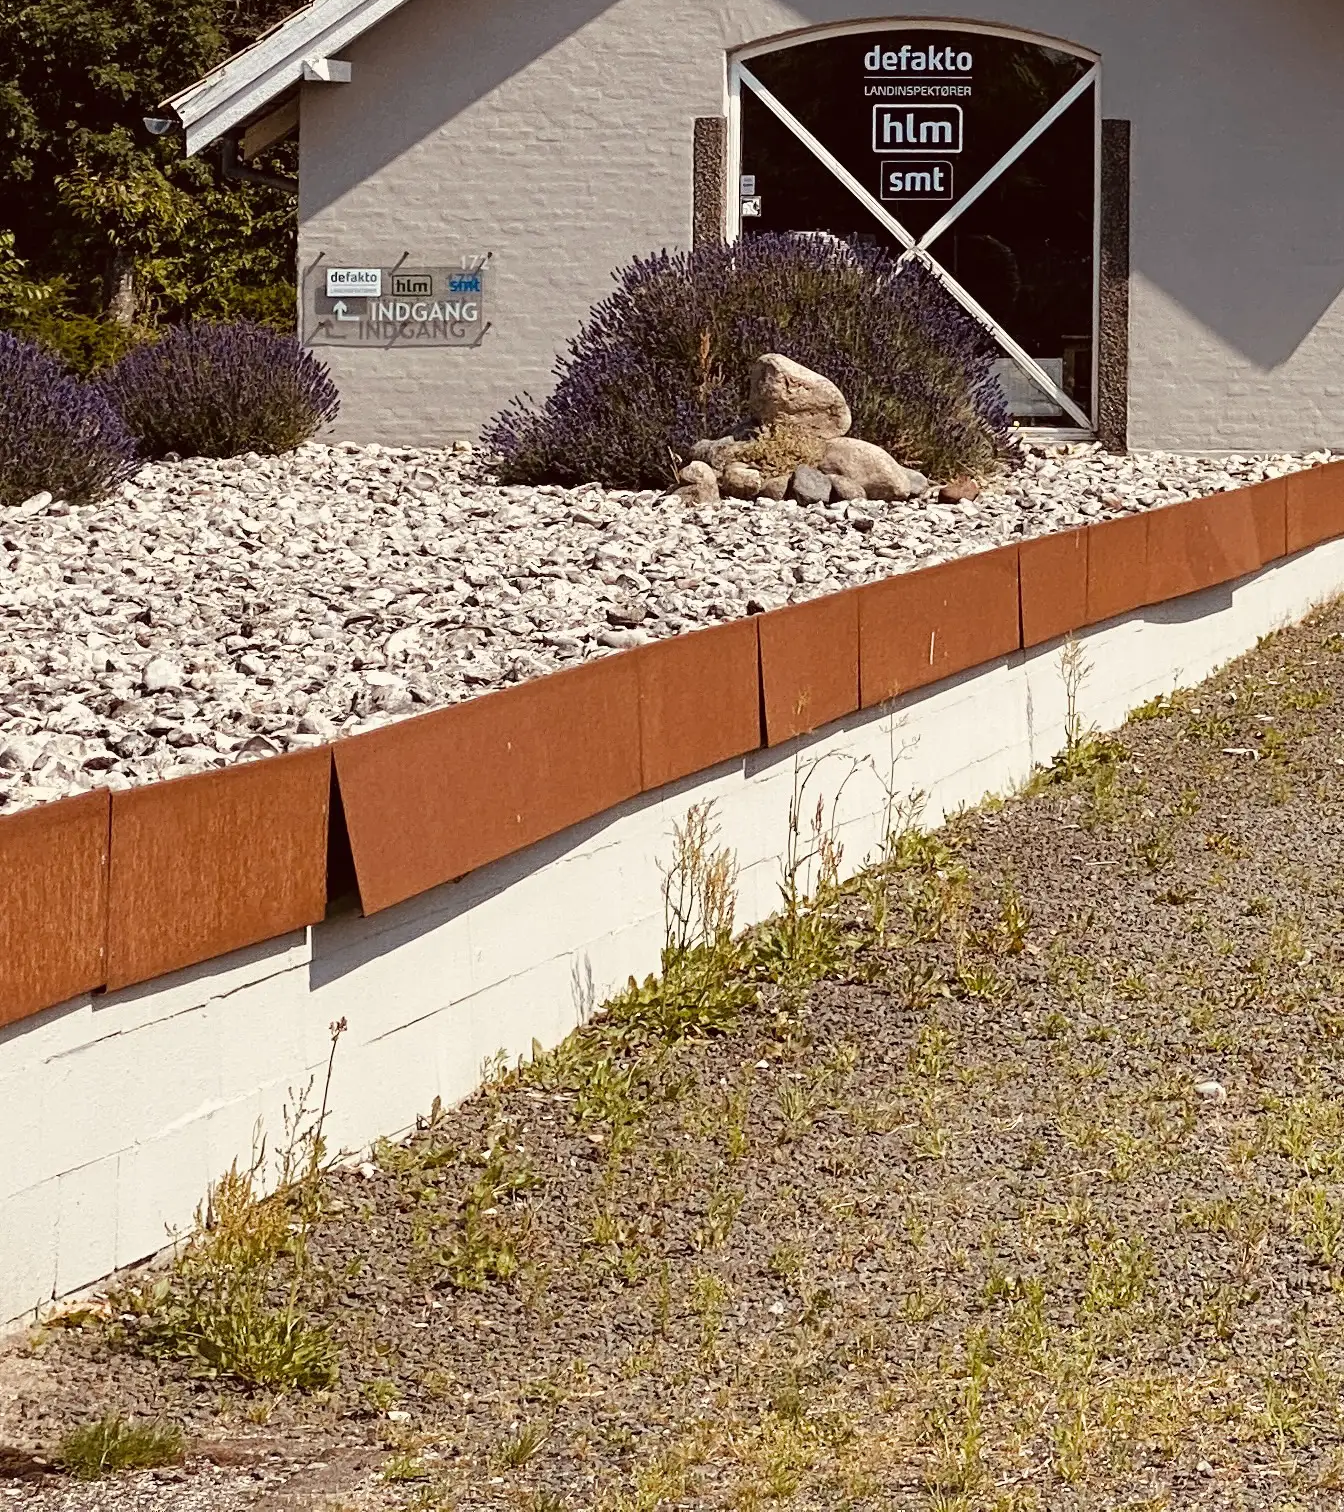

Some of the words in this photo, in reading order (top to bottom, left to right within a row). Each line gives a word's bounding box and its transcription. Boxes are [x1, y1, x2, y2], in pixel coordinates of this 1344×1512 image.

[864, 45, 973, 71] defakto
[864, 86, 972, 96] LANDINSPEKTØRER
[883, 113, 952, 143] hlm
[889, 167, 944, 192] smt
[331, 271, 378, 283] defakto
[396, 279, 428, 293] hlm
[448, 278, 481, 293] smt
[371, 302, 478, 321] INDGANG
